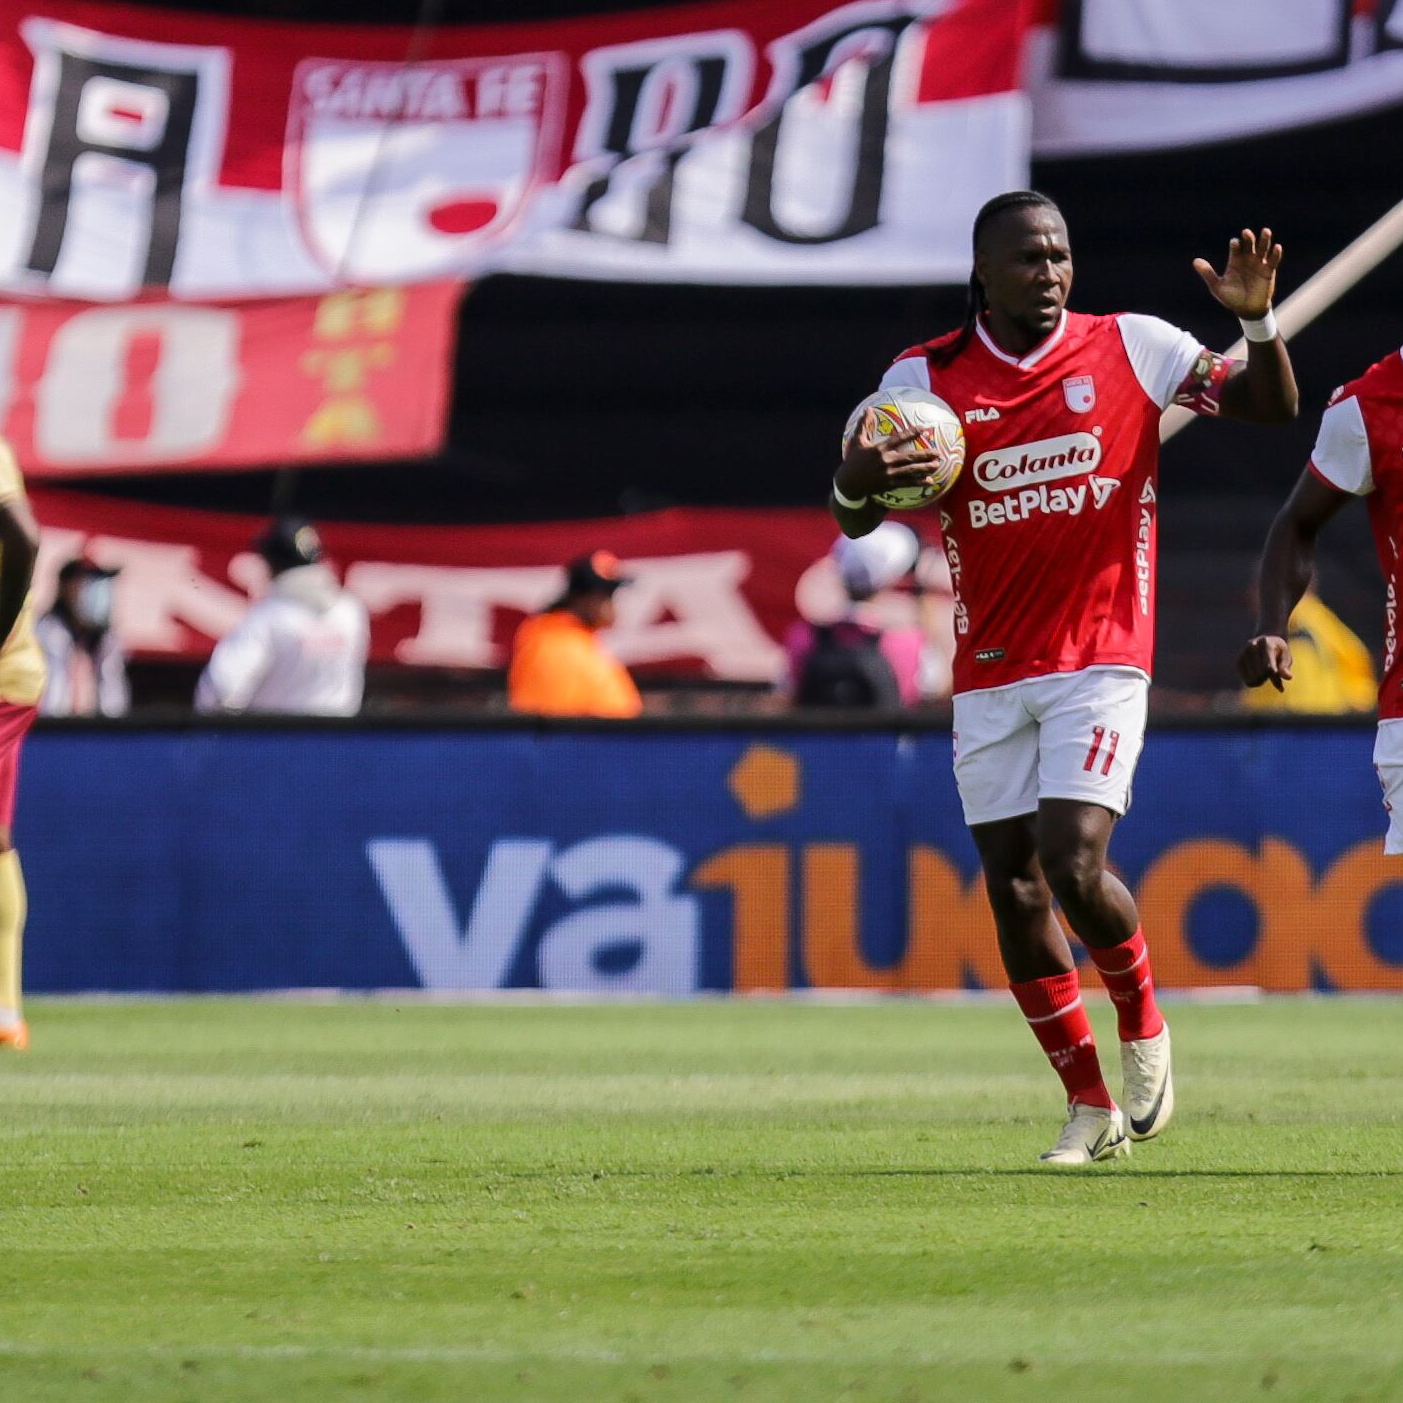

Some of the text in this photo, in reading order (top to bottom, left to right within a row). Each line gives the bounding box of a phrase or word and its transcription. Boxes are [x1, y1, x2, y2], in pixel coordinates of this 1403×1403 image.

[305, 62, 542, 119] SANTA FE
[964, 407, 1000, 425] FILA
[977, 445, 1095, 483] Colanta
[967, 484, 1087, 529] BetPlay
[1082, 725, 1121, 777] 11
